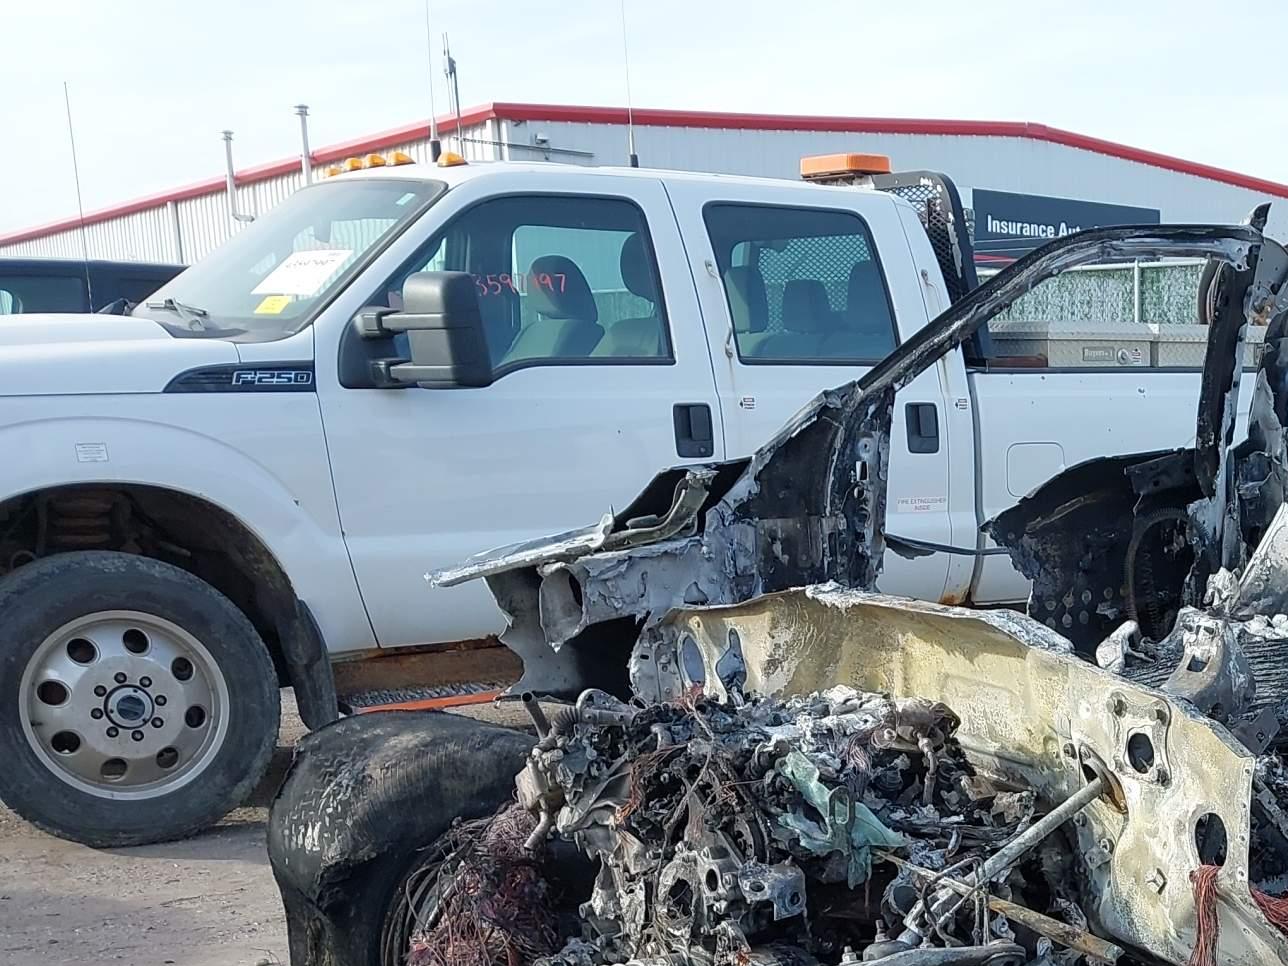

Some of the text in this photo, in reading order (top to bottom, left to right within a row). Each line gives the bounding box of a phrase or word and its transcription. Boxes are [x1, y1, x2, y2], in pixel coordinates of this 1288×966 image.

[987, 214, 1082, 237] Insurance Aut
[232, 370, 313, 385] F-250
